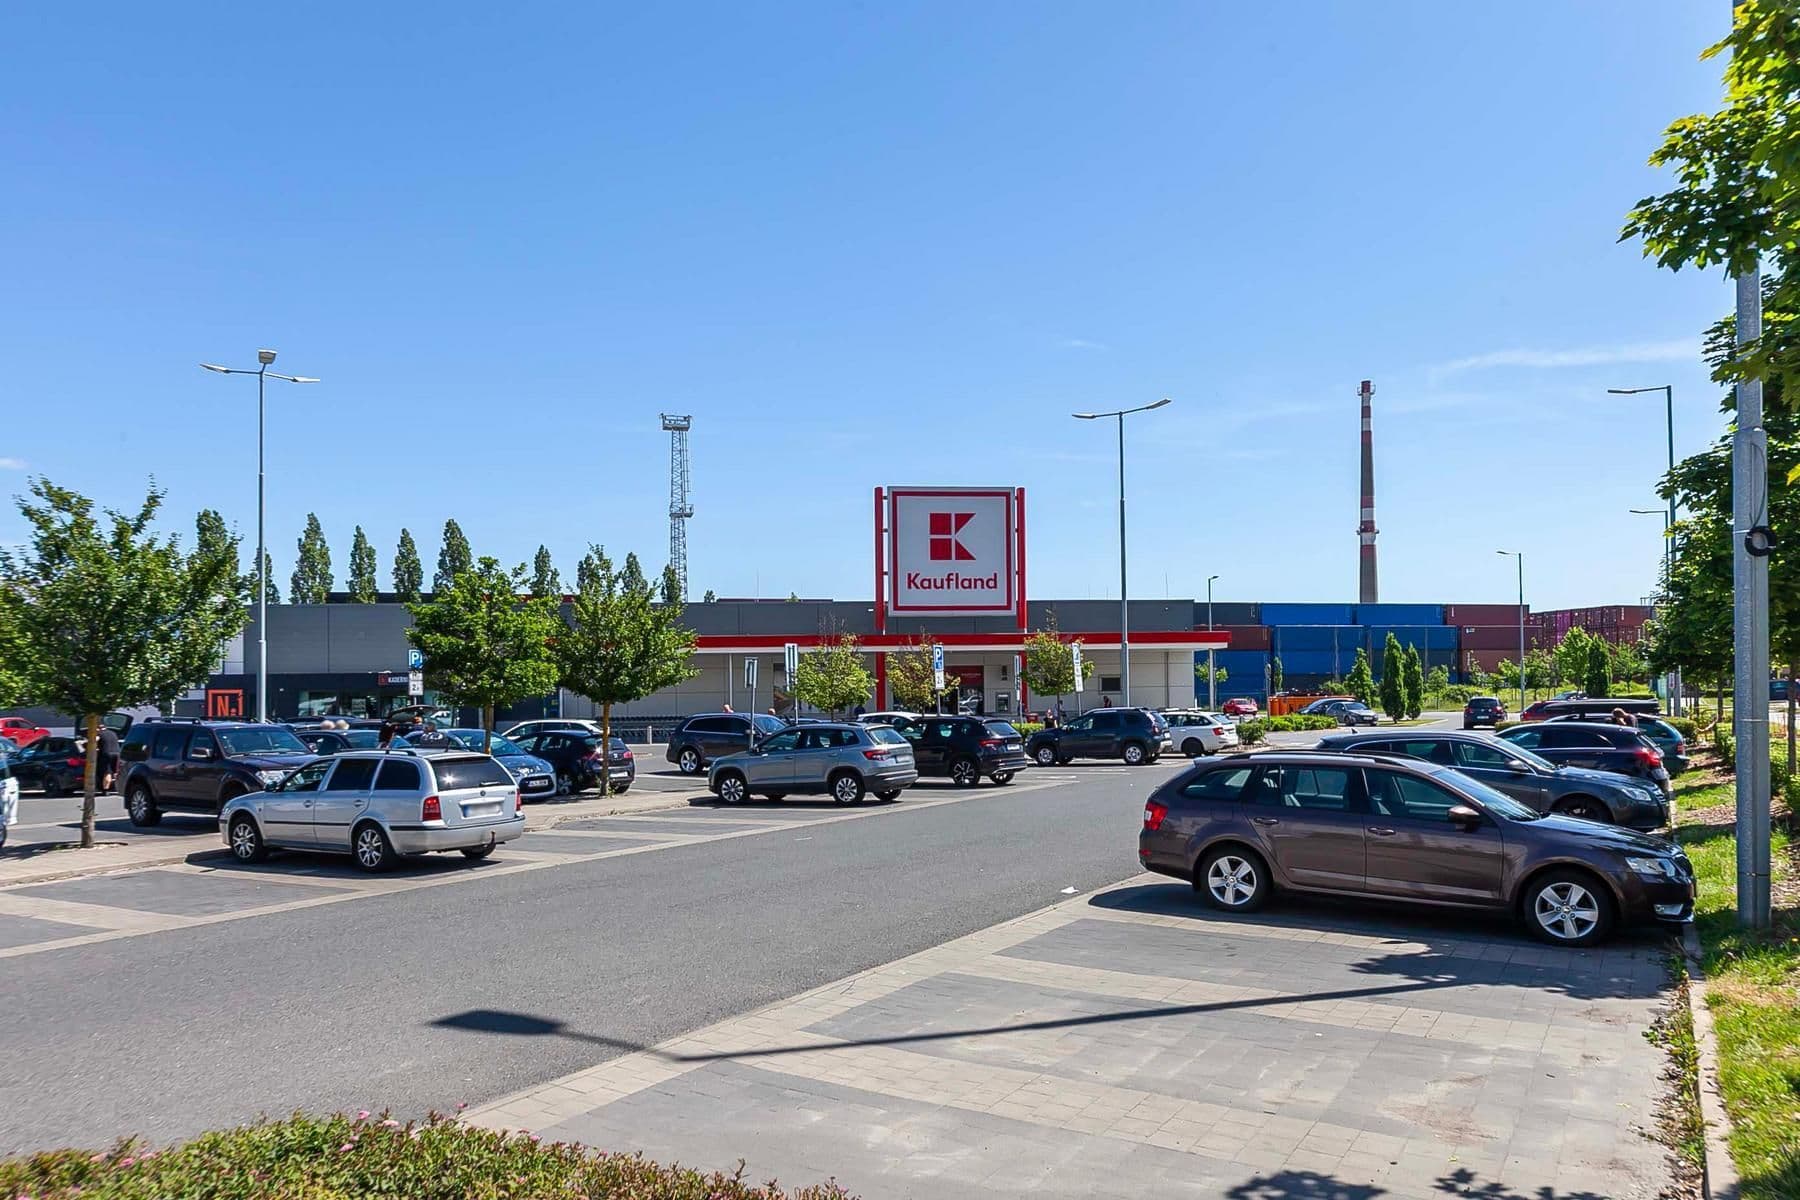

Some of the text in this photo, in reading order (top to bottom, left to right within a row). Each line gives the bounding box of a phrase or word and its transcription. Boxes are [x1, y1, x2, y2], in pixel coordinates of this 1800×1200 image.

[929, 512, 977, 561] K
[907, 572, 998, 590] Kaufland
[411, 652, 420, 665] P
